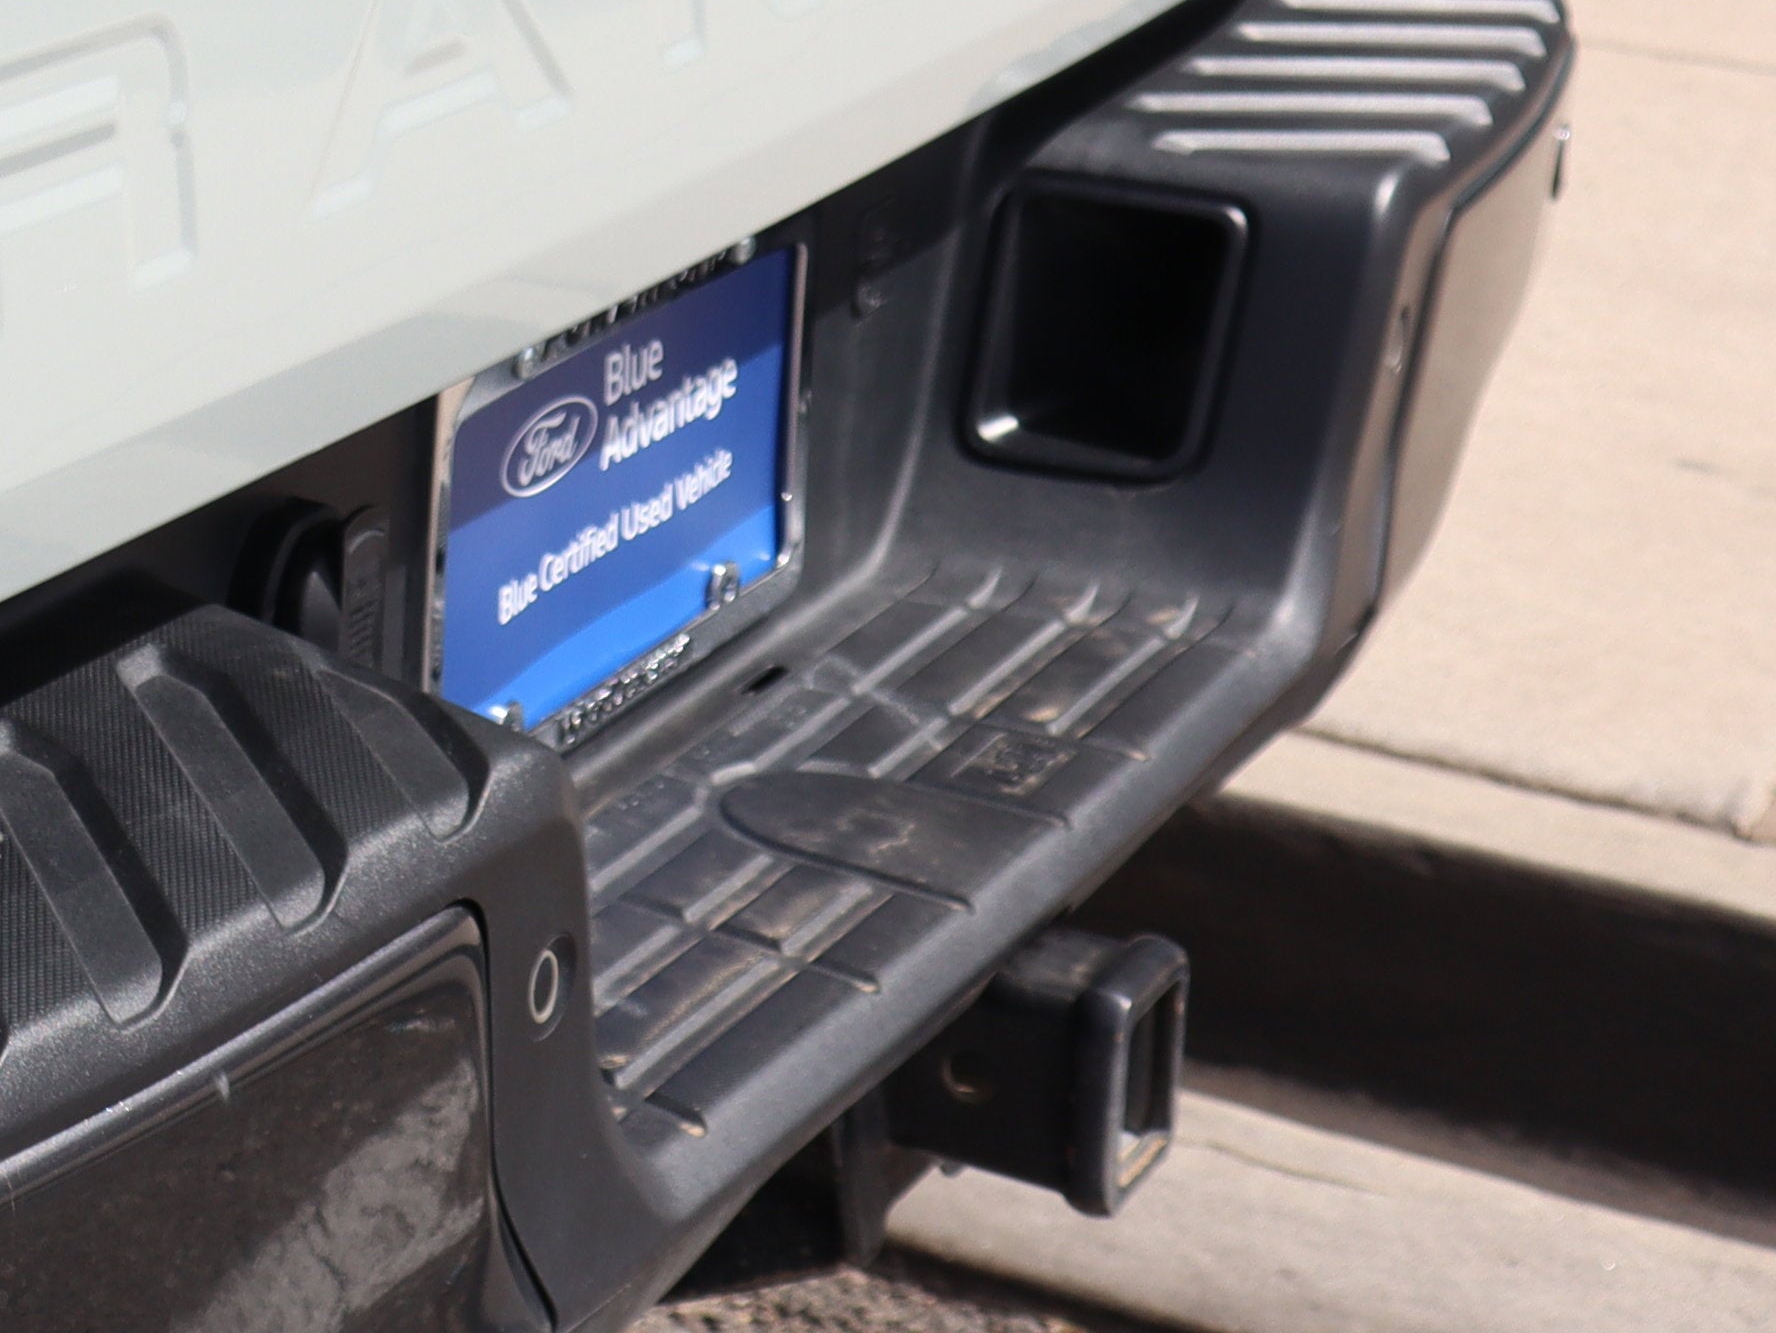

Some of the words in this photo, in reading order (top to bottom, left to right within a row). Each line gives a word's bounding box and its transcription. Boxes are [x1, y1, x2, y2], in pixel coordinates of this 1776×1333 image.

[598, 356, 739, 471] Advantage
[603, 338, 664, 406] Blue
[516, 410, 582, 486] Ford
[496, 573, 538, 626] Blue
[538, 512, 619, 593] Certified
[620, 488, 673, 543] Used
[674, 447, 733, 512] Vehicle
